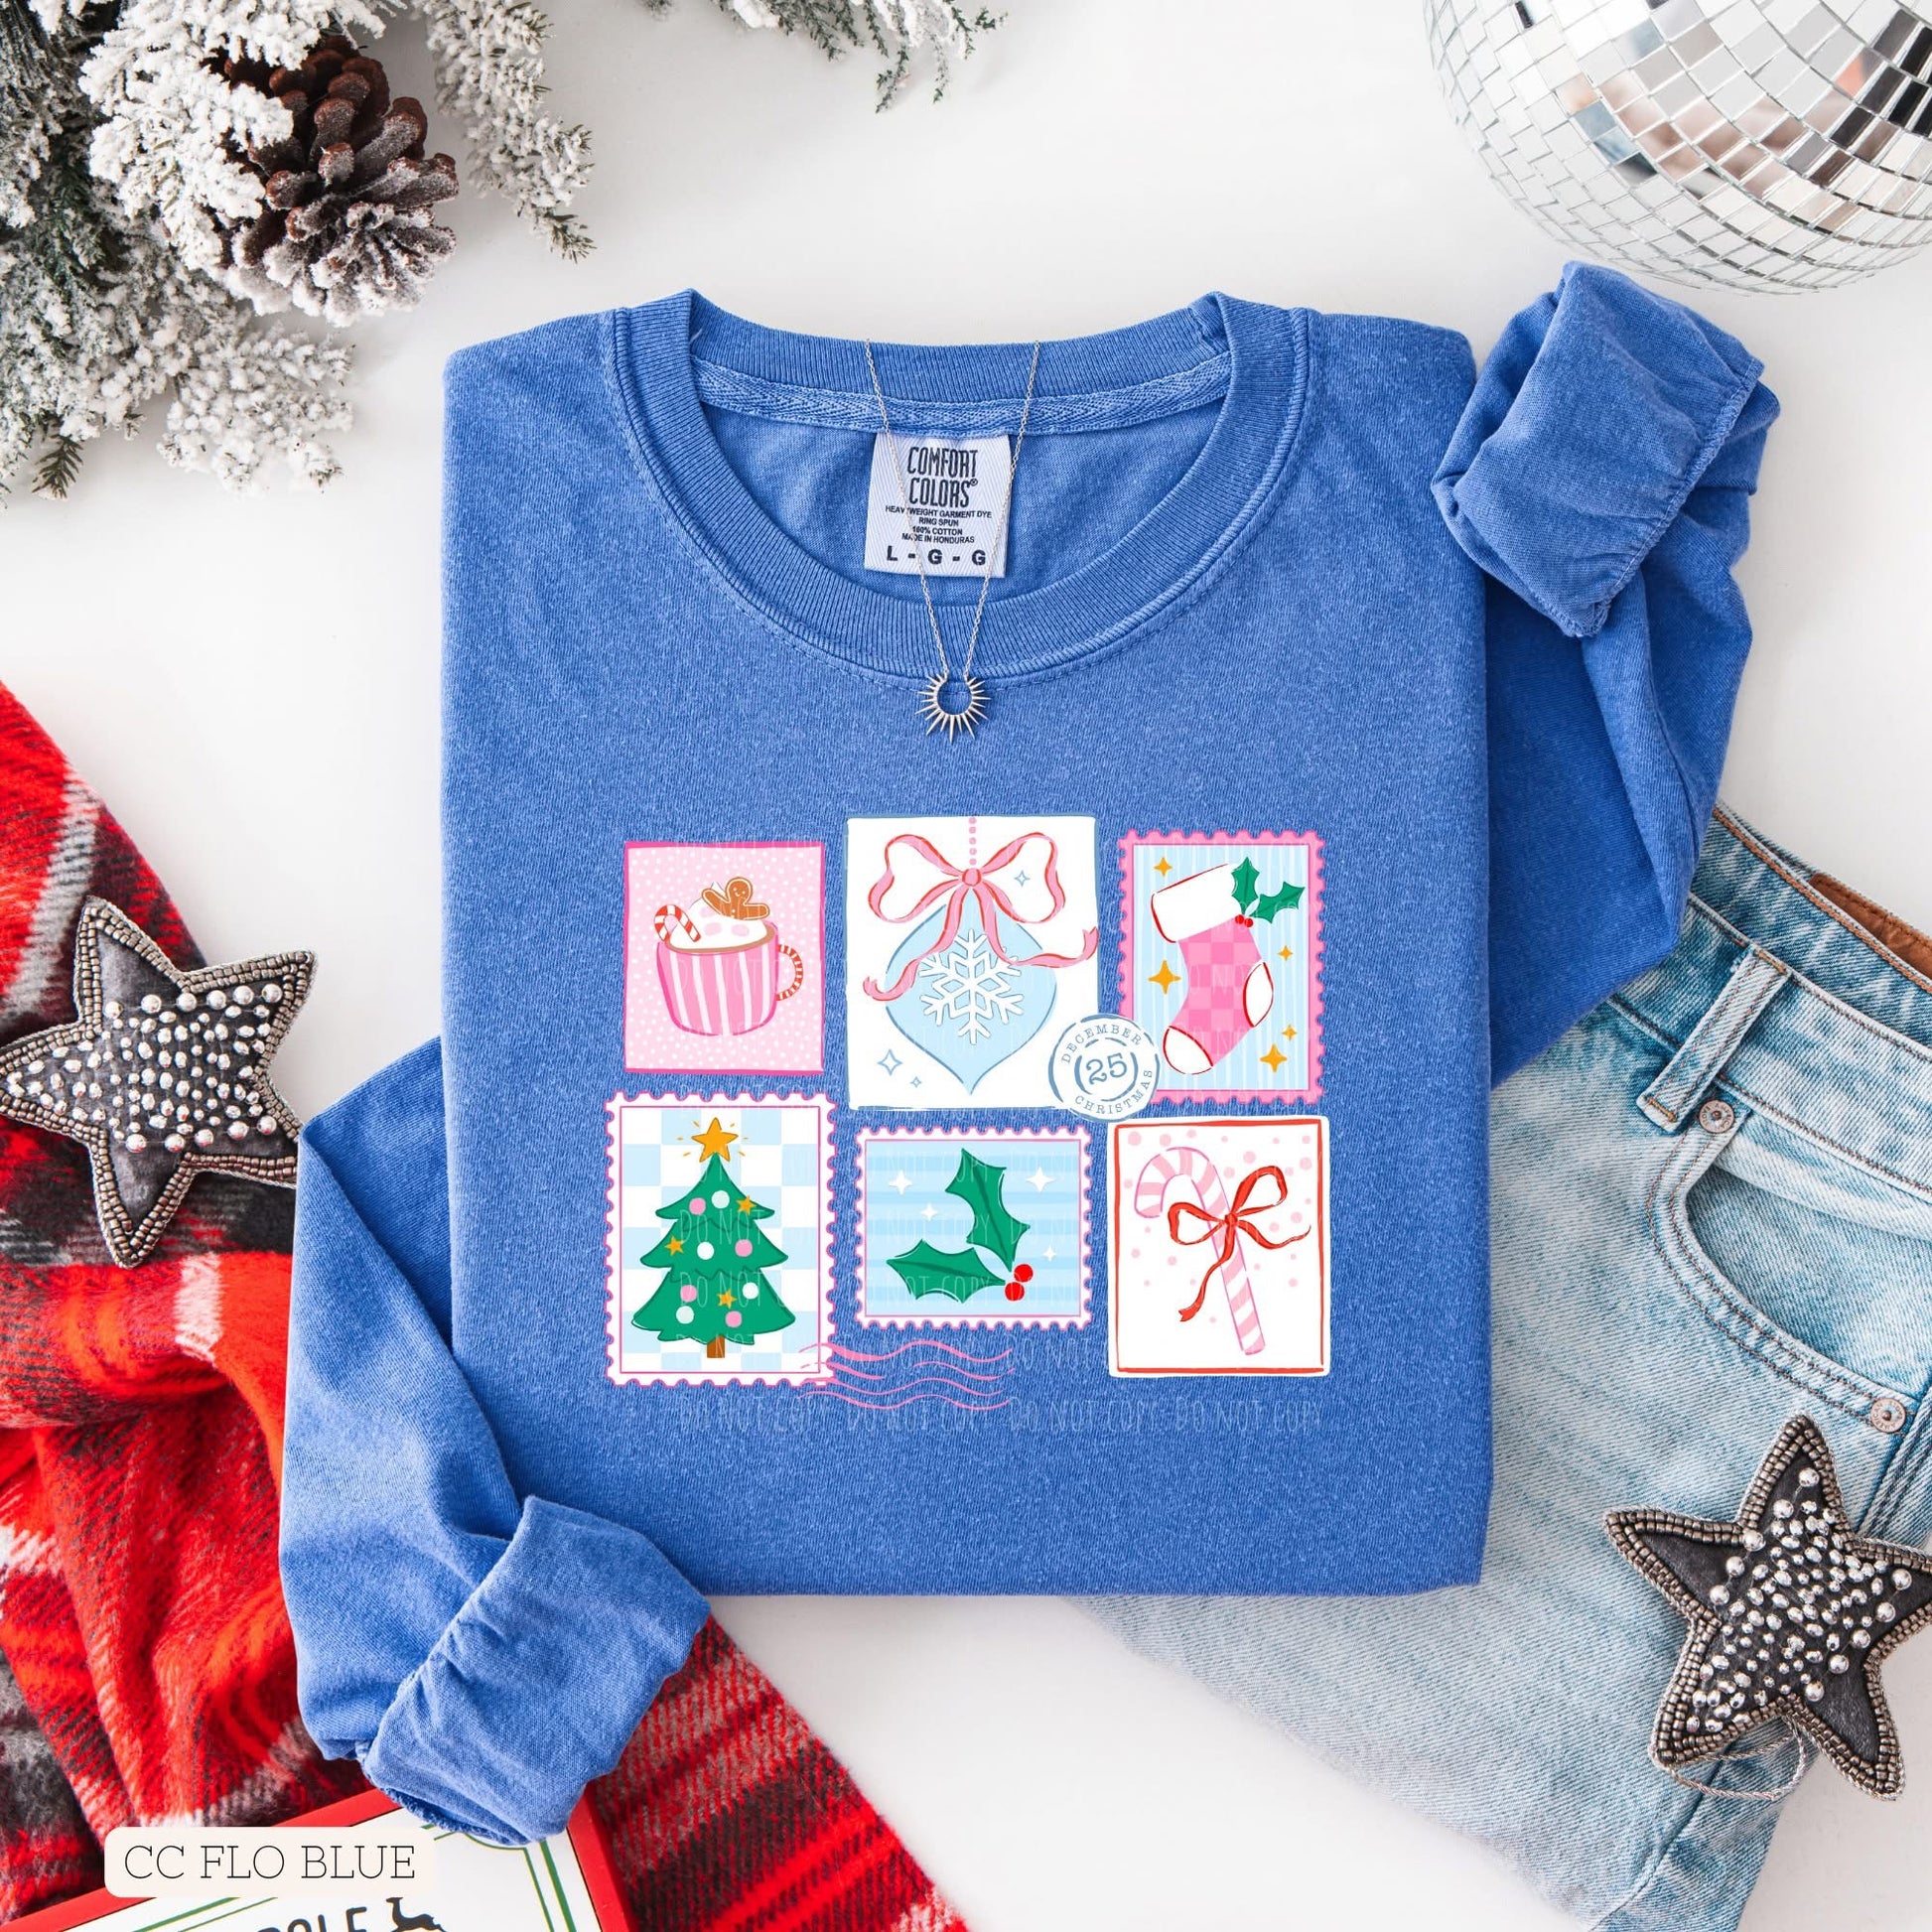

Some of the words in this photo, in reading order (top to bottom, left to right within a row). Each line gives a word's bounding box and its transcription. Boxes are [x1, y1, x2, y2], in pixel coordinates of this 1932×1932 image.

[907, 447, 978, 478] COMFORT
[887, 545, 898, 561] L
[927, 548, 942, 565] G
[971, 550, 986, 566] G
[1061, 1024, 1142, 1064] DECEMBER
[1085, 1052, 1127, 1085] 25
[1075, 1069, 1153, 1114] CHRISTMAS
